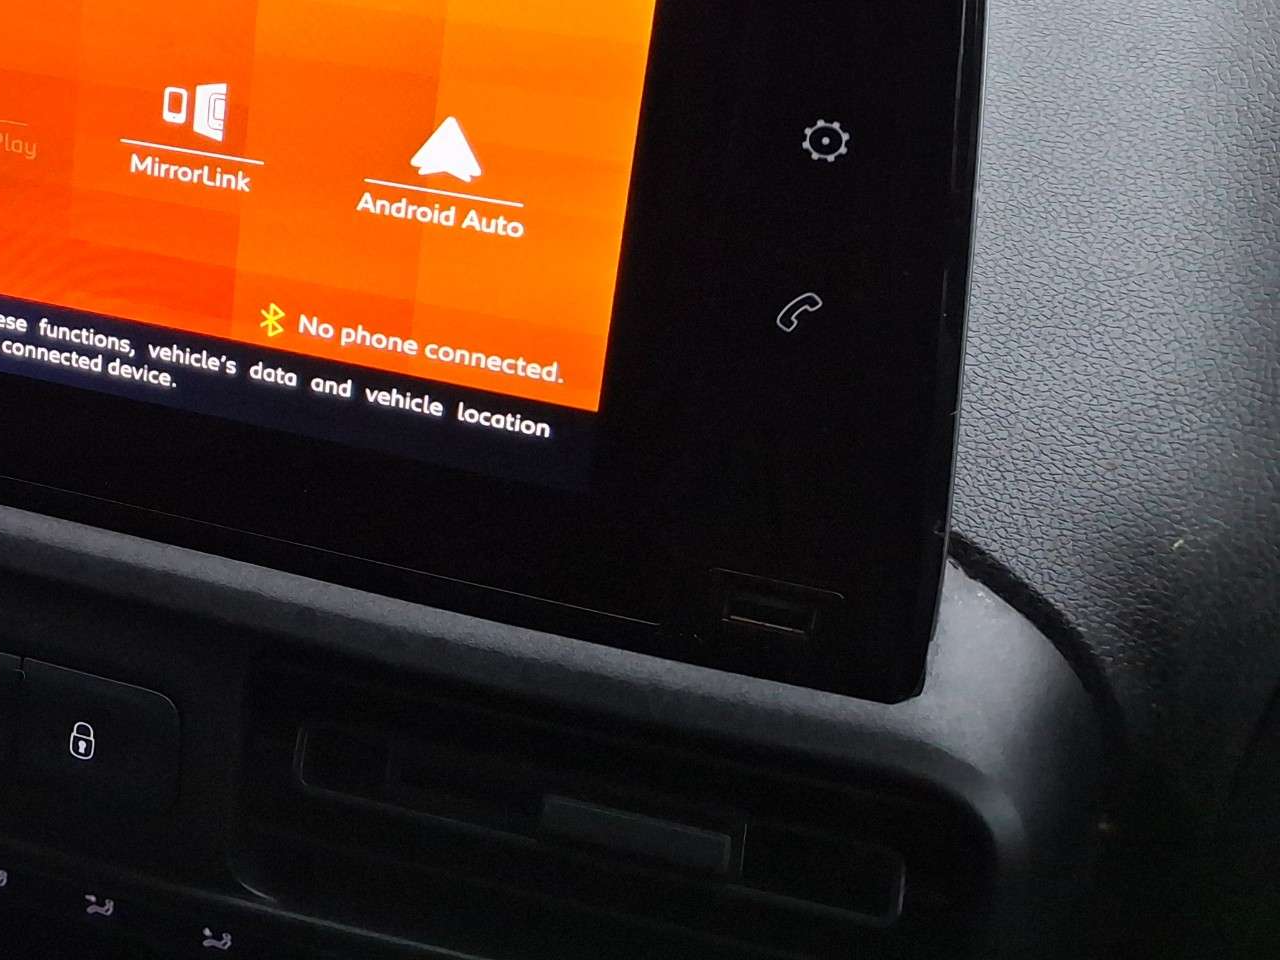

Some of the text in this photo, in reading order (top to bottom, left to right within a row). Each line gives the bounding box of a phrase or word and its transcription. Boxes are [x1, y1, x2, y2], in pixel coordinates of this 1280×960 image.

[130, 153, 250, 192] MirrorLink
[357, 193, 524, 238] Android Auto
[2, 337, 102, 371] connected
[108, 357, 177, 387] device.
[298, 314, 564, 383] No phone connected.
[39, 318, 135, 357] functions,
[149, 340, 237, 375] vehicle's
[249, 360, 297, 387] data
[311, 374, 352, 397] and
[365, 384, 443, 417] vehicle
[457, 401, 551, 439] location
